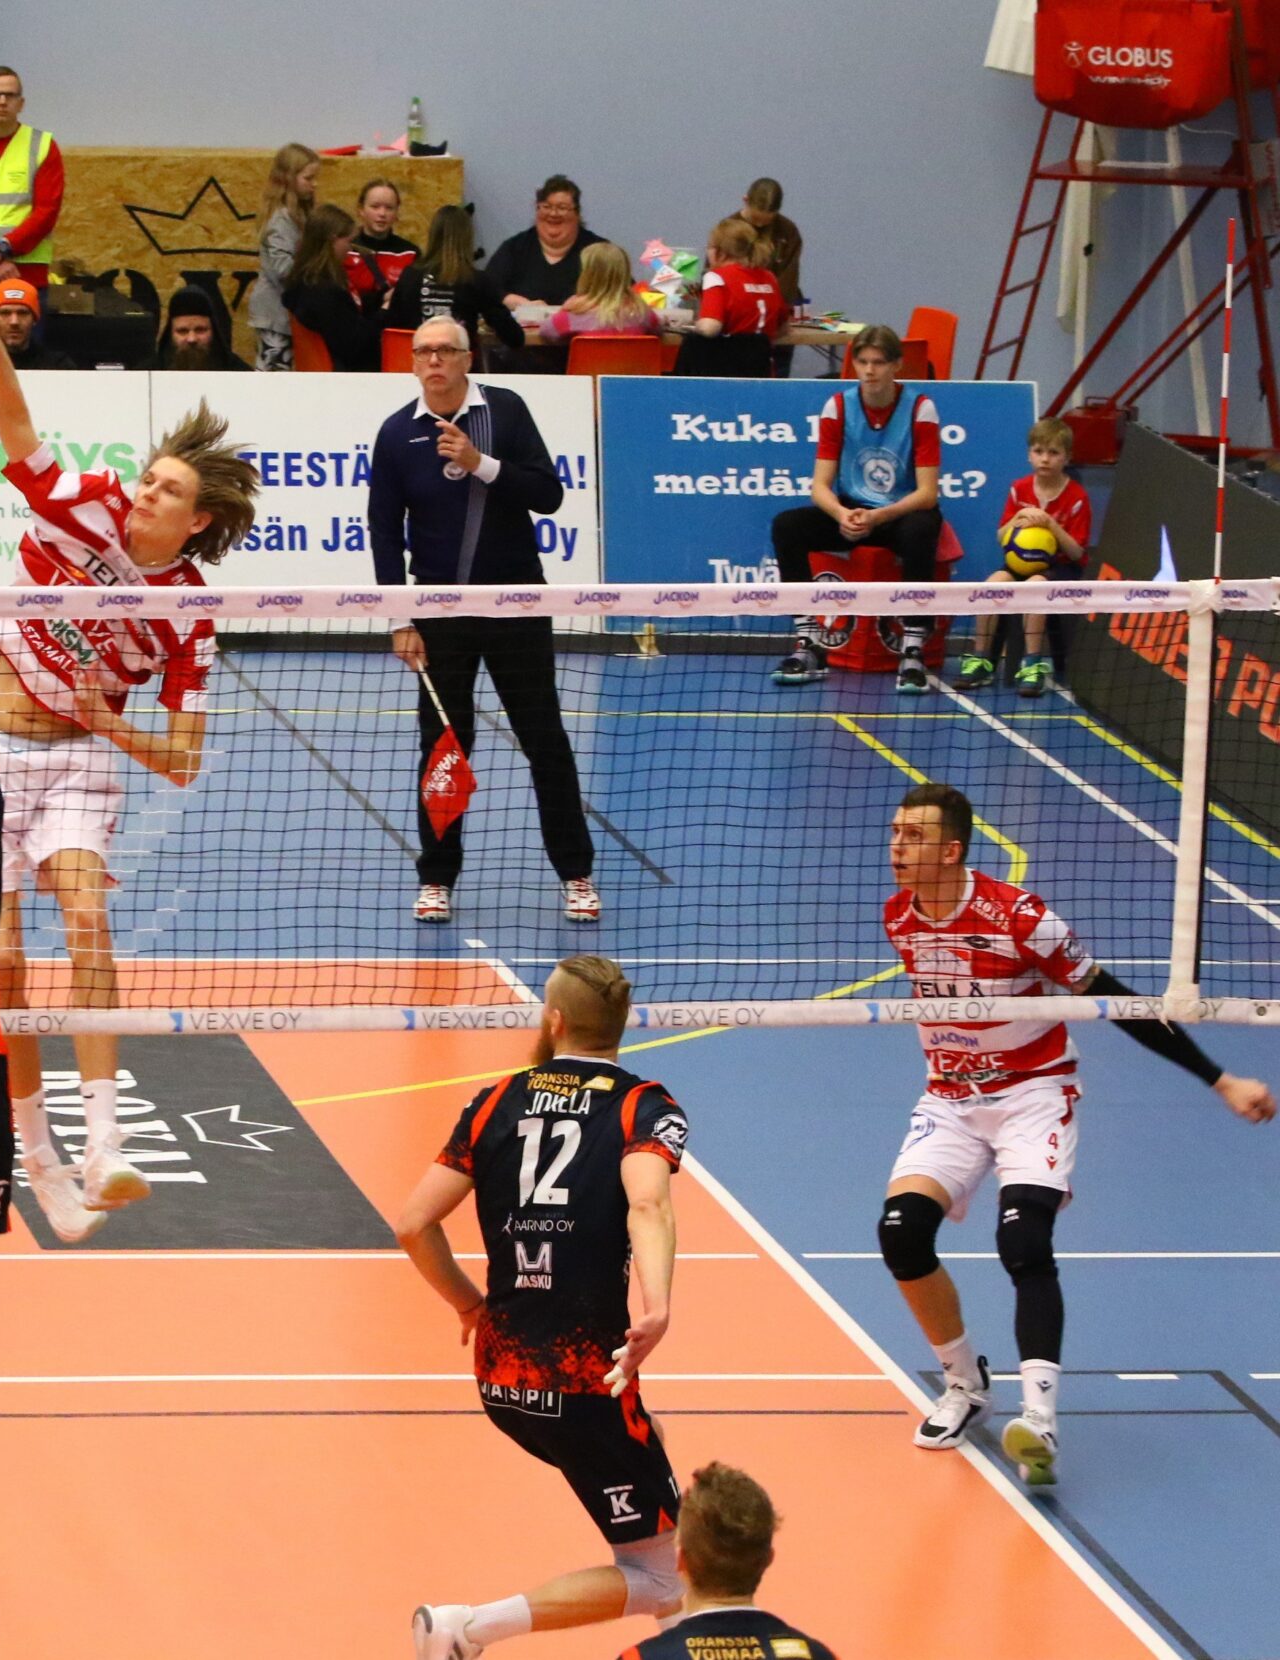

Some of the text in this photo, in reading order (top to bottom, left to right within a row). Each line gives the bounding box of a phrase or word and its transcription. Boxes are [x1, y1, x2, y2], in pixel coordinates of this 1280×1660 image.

[1087, 46, 1174, 69] GLOBUS
[671, 413, 798, 444] Kuka
[236, 444, 371, 487] TEESTÄ
[535, 517, 578, 562] Oy
[707, 557, 781, 584] Tyrvä
[16, 594, 63, 607] JACKON
[97, 594, 144, 607] JACKON
[177, 595, 223, 609] JACKON
[257, 594, 303, 608] JACKON
[336, 593, 382, 607] JACKON
[416, 593, 462, 607] JACKON
[495, 592, 541, 607] JACKON
[575, 592, 620, 606] JACKON
[654, 592, 699, 605] JACKON
[732, 591, 778, 605] JACKON
[811, 590, 857, 604] JACKON
[890, 590, 936, 603] JACKON
[969, 589, 1014, 603] JACKON
[1047, 588, 1092, 602] JACKON
[1125, 587, 1170, 601] JACKON
[36, 1015, 68, 1033] OY
[190, 1013, 265, 1030] VEXVE
[270, 1012, 303, 1030] OY
[422, 1011, 497, 1030] VEXVE
[501, 1010, 534, 1029] OY
[655, 1008, 730, 1026] VEXVE
[735, 1007, 766, 1025] OY
[886, 1003, 960, 1021] VEXVE
[965, 1001, 996, 1019] OY
[1114, 1000, 1160, 1018] VEX
[1048, 1132, 1059, 1150] 4
[517, 1117, 582, 1207] 12
[514, 1219, 575, 1233] AARNIO OY
[514, 1274, 552, 1290] MASKU
[685, 1635, 761, 1649] ORANSSIA
[688, 1646, 766, 1660] VOIMAA
